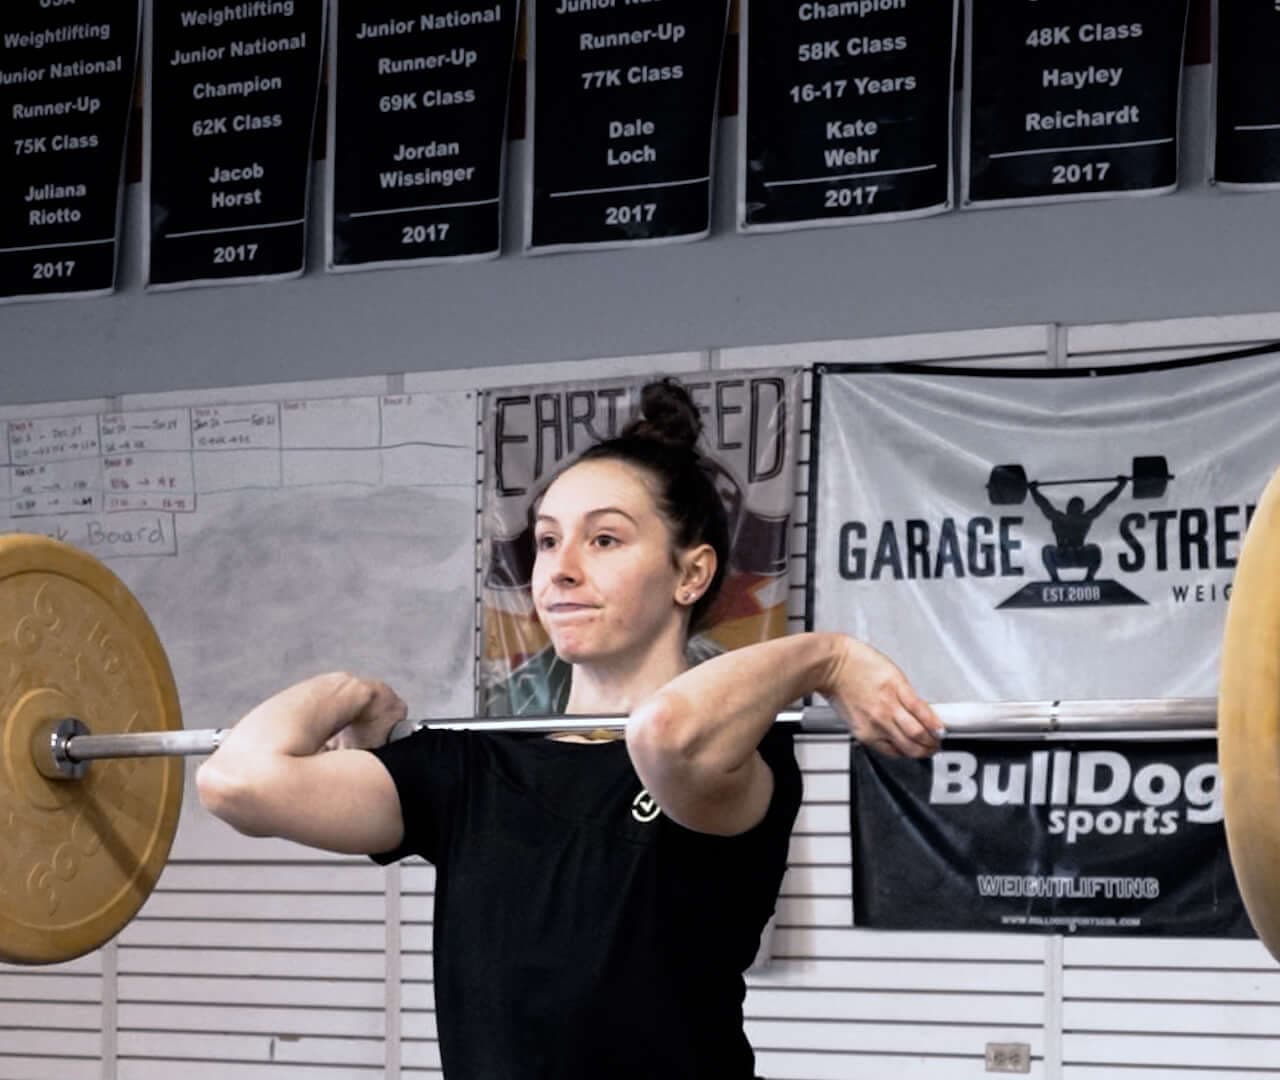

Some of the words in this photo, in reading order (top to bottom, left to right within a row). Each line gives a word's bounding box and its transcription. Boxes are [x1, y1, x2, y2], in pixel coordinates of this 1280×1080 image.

[181, 0, 294, 26] Weightlifting
[799, 0, 906, 21] Champion
[356, 20, 414, 39] Junior
[421, 5, 500, 30] National
[4, 24, 110, 48] Weightlifting
[580, 23, 685, 50] Runner-Up
[1026, 26, 1070, 46] 48K
[1079, 24, 1142, 42] Class
[171, 47, 225, 65] Junior
[231, 33, 305, 57] National
[799, 41, 839, 61] 58K
[847, 37, 906, 55] Class
[50, 56, 121, 78] National
[379, 48, 477, 74] Runner-Up
[193, 76, 281, 99] Champion
[582, 69, 620, 89] 77K
[628, 66, 683, 83] Class
[1043, 66, 1122, 89] Hayley
[790, 80, 847, 102] 16-17
[854, 76, 916, 95] Years
[13, 96, 100, 119] Runner-Up
[380, 93, 416, 112] 69K
[423, 90, 475, 107] Class
[193, 118, 226, 136] 62K
[233, 115, 282, 131] Class
[610, 119, 654, 138] Dale
[827, 120, 877, 139] Kate
[1026, 106, 1139, 131] Reichardt
[15, 137, 46, 154] 75K
[52, 135, 98, 150] Class
[394, 141, 459, 161] Jordan
[608, 145, 656, 165] Loch
[824, 147, 879, 167] Wehr
[209, 163, 264, 183] Jacob
[380, 168, 474, 188] Wissinger
[1053, 163, 1109, 184] 2017
[25, 184, 86, 201] Juliana
[212, 189, 261, 208] Horst
[825, 185, 878, 207] 2017
[30, 208, 81, 225] Riotto
[606, 204, 656, 224] 2017
[402, 224, 449, 243] 2017
[214, 244, 258, 263] 2017
[33, 261, 75, 279] 2017
[88, 518, 165, 546] Board
[838, 516, 1024, 581] GARAGE
[1068, 585, 1100, 601] 2008
[930, 750, 1224, 824] BullDog
[1047, 809, 1179, 844] sports
[977, 875, 1160, 898] WEIGHTLIFTING
